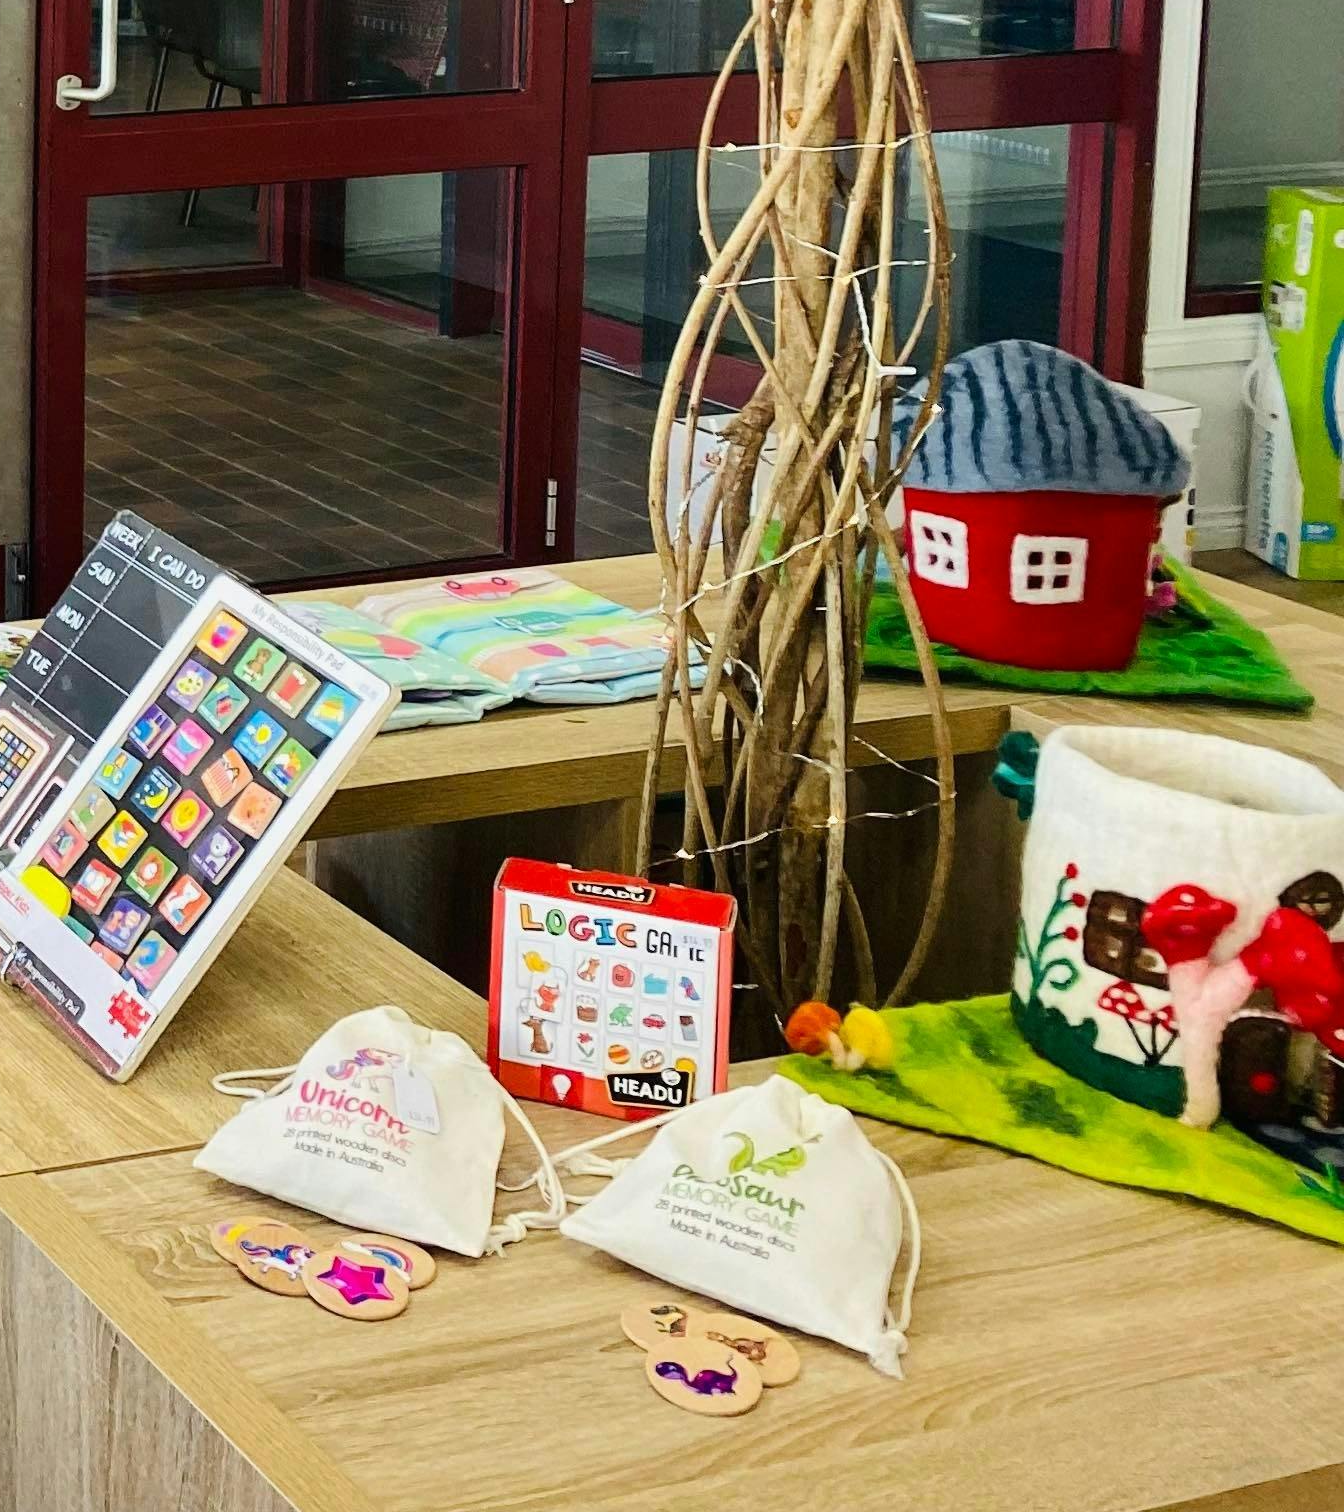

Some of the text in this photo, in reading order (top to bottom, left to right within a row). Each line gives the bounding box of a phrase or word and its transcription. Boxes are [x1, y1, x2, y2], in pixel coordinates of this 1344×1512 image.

[112, 520, 144, 551] WEEK
[86, 560, 117, 587] SUN
[147, 545, 207, 590] I CAN DO
[55, 603, 86, 632] MON
[24, 648, 53, 678] TUE
[323, 650, 346, 672] Pad
[575, 882, 646, 902] HEADU
[519, 903, 637, 949] LOGIC
[63, 998, 81, 1017] Pad
[614, 1076, 683, 1105] HEADU
[300, 1079, 412, 1135] Unicorn
[285, 1105, 415, 1153] MEMORY GAME
[294, 1141, 385, 1173] Made in Australia
[297, 1129, 333, 1145] printed
[334, 1136, 380, 1157] wooden
[381, 1147, 408, 1168] discs
[661, 1180, 800, 1238] MEMORY GAME
[654, 1198, 797, 1253] 28 printed wooden discs
[669, 1218, 770, 1261] Made in Australia
